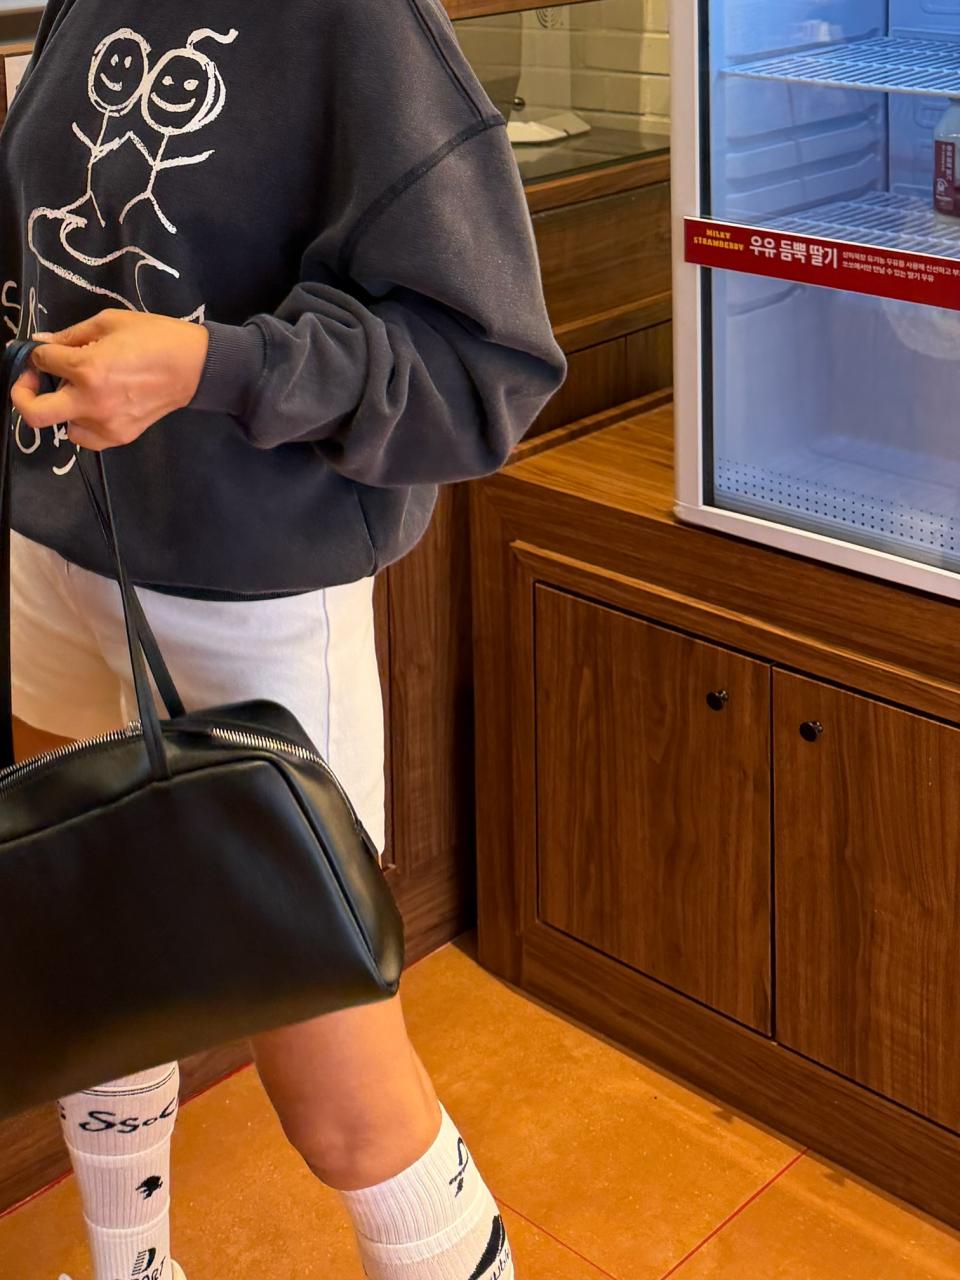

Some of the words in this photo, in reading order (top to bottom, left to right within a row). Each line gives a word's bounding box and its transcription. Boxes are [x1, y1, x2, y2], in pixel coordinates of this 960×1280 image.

[706, 228, 731, 239] MILKY
[693, 236, 744, 251] STRAWBERRY
[749, 235, 777, 258] 우유
[779, 239, 808, 264] 듬뿍
[809, 244, 838, 269] 딸기
